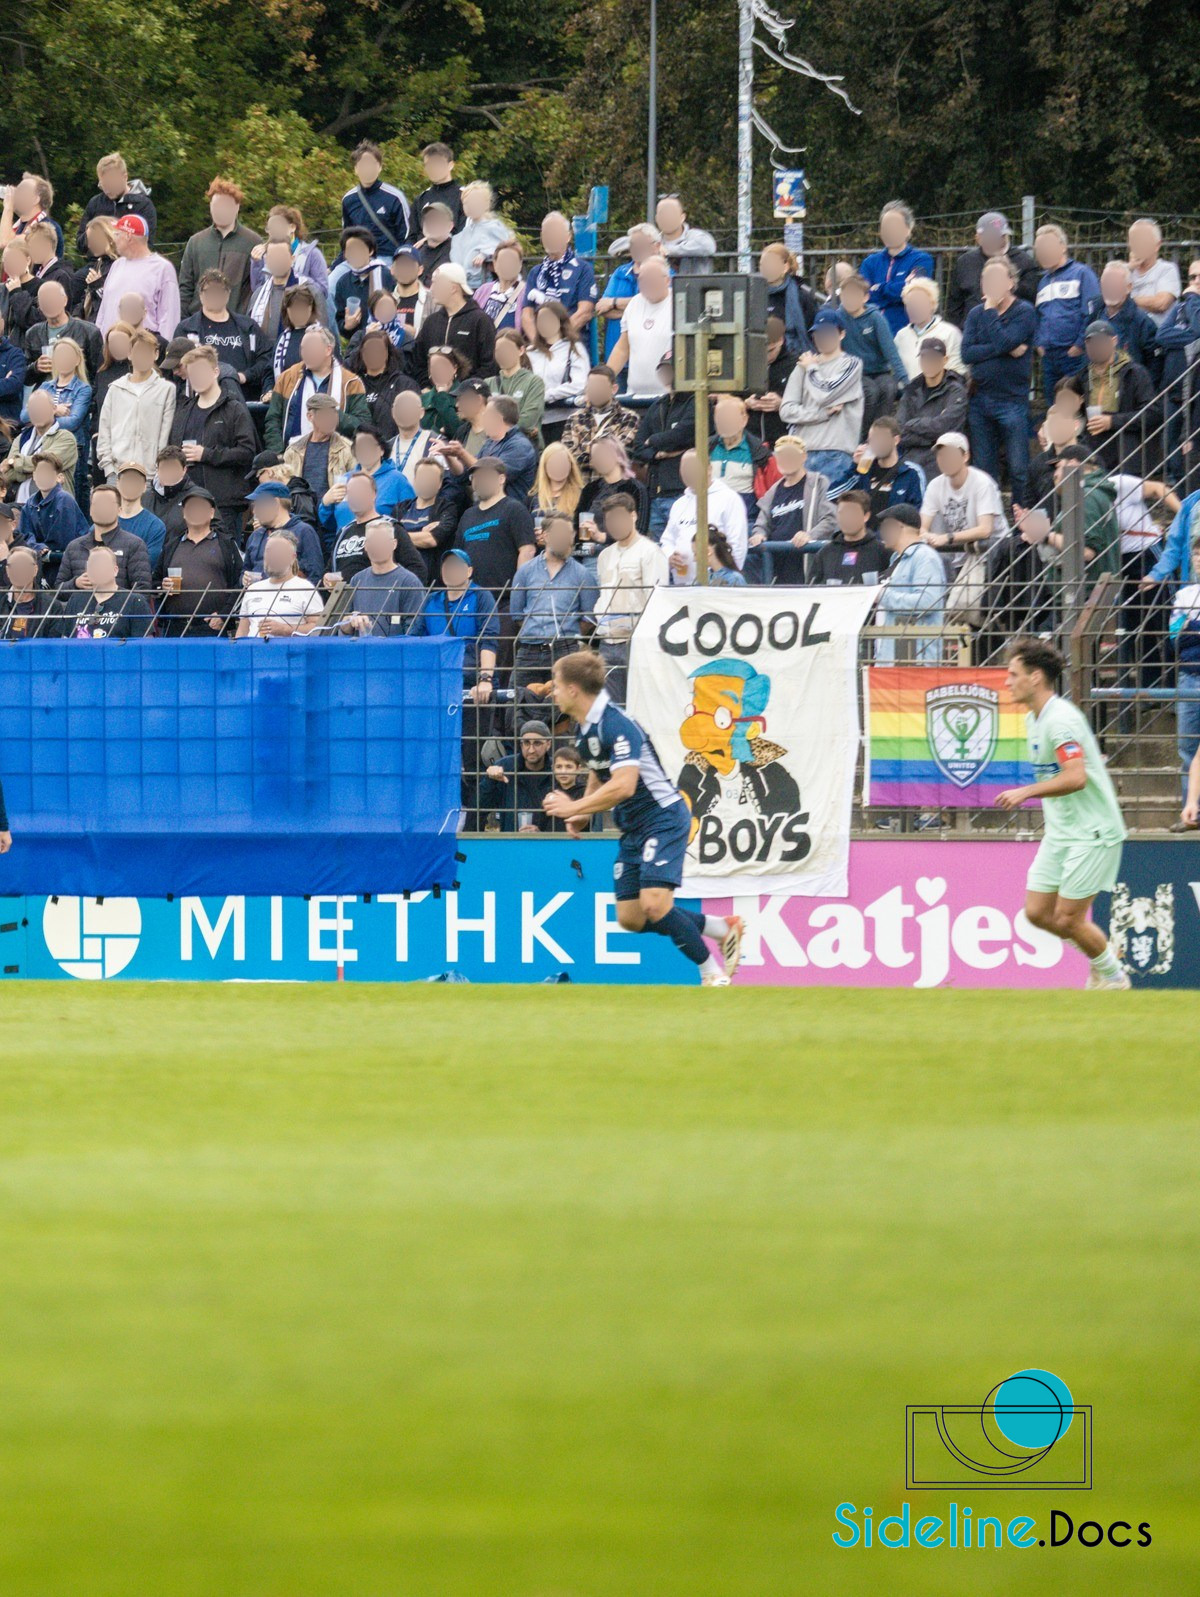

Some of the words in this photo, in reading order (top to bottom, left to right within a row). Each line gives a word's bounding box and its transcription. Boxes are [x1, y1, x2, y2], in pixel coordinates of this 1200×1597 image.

[658, 603, 831, 656] COOOL
[947, 761, 977, 770] UNITED
[642, 837, 659, 863] 6
[699, 812, 812, 864] BOYS
[180, 890, 642, 964] MIETHKE
[733, 877, 1064, 988] Katjes
